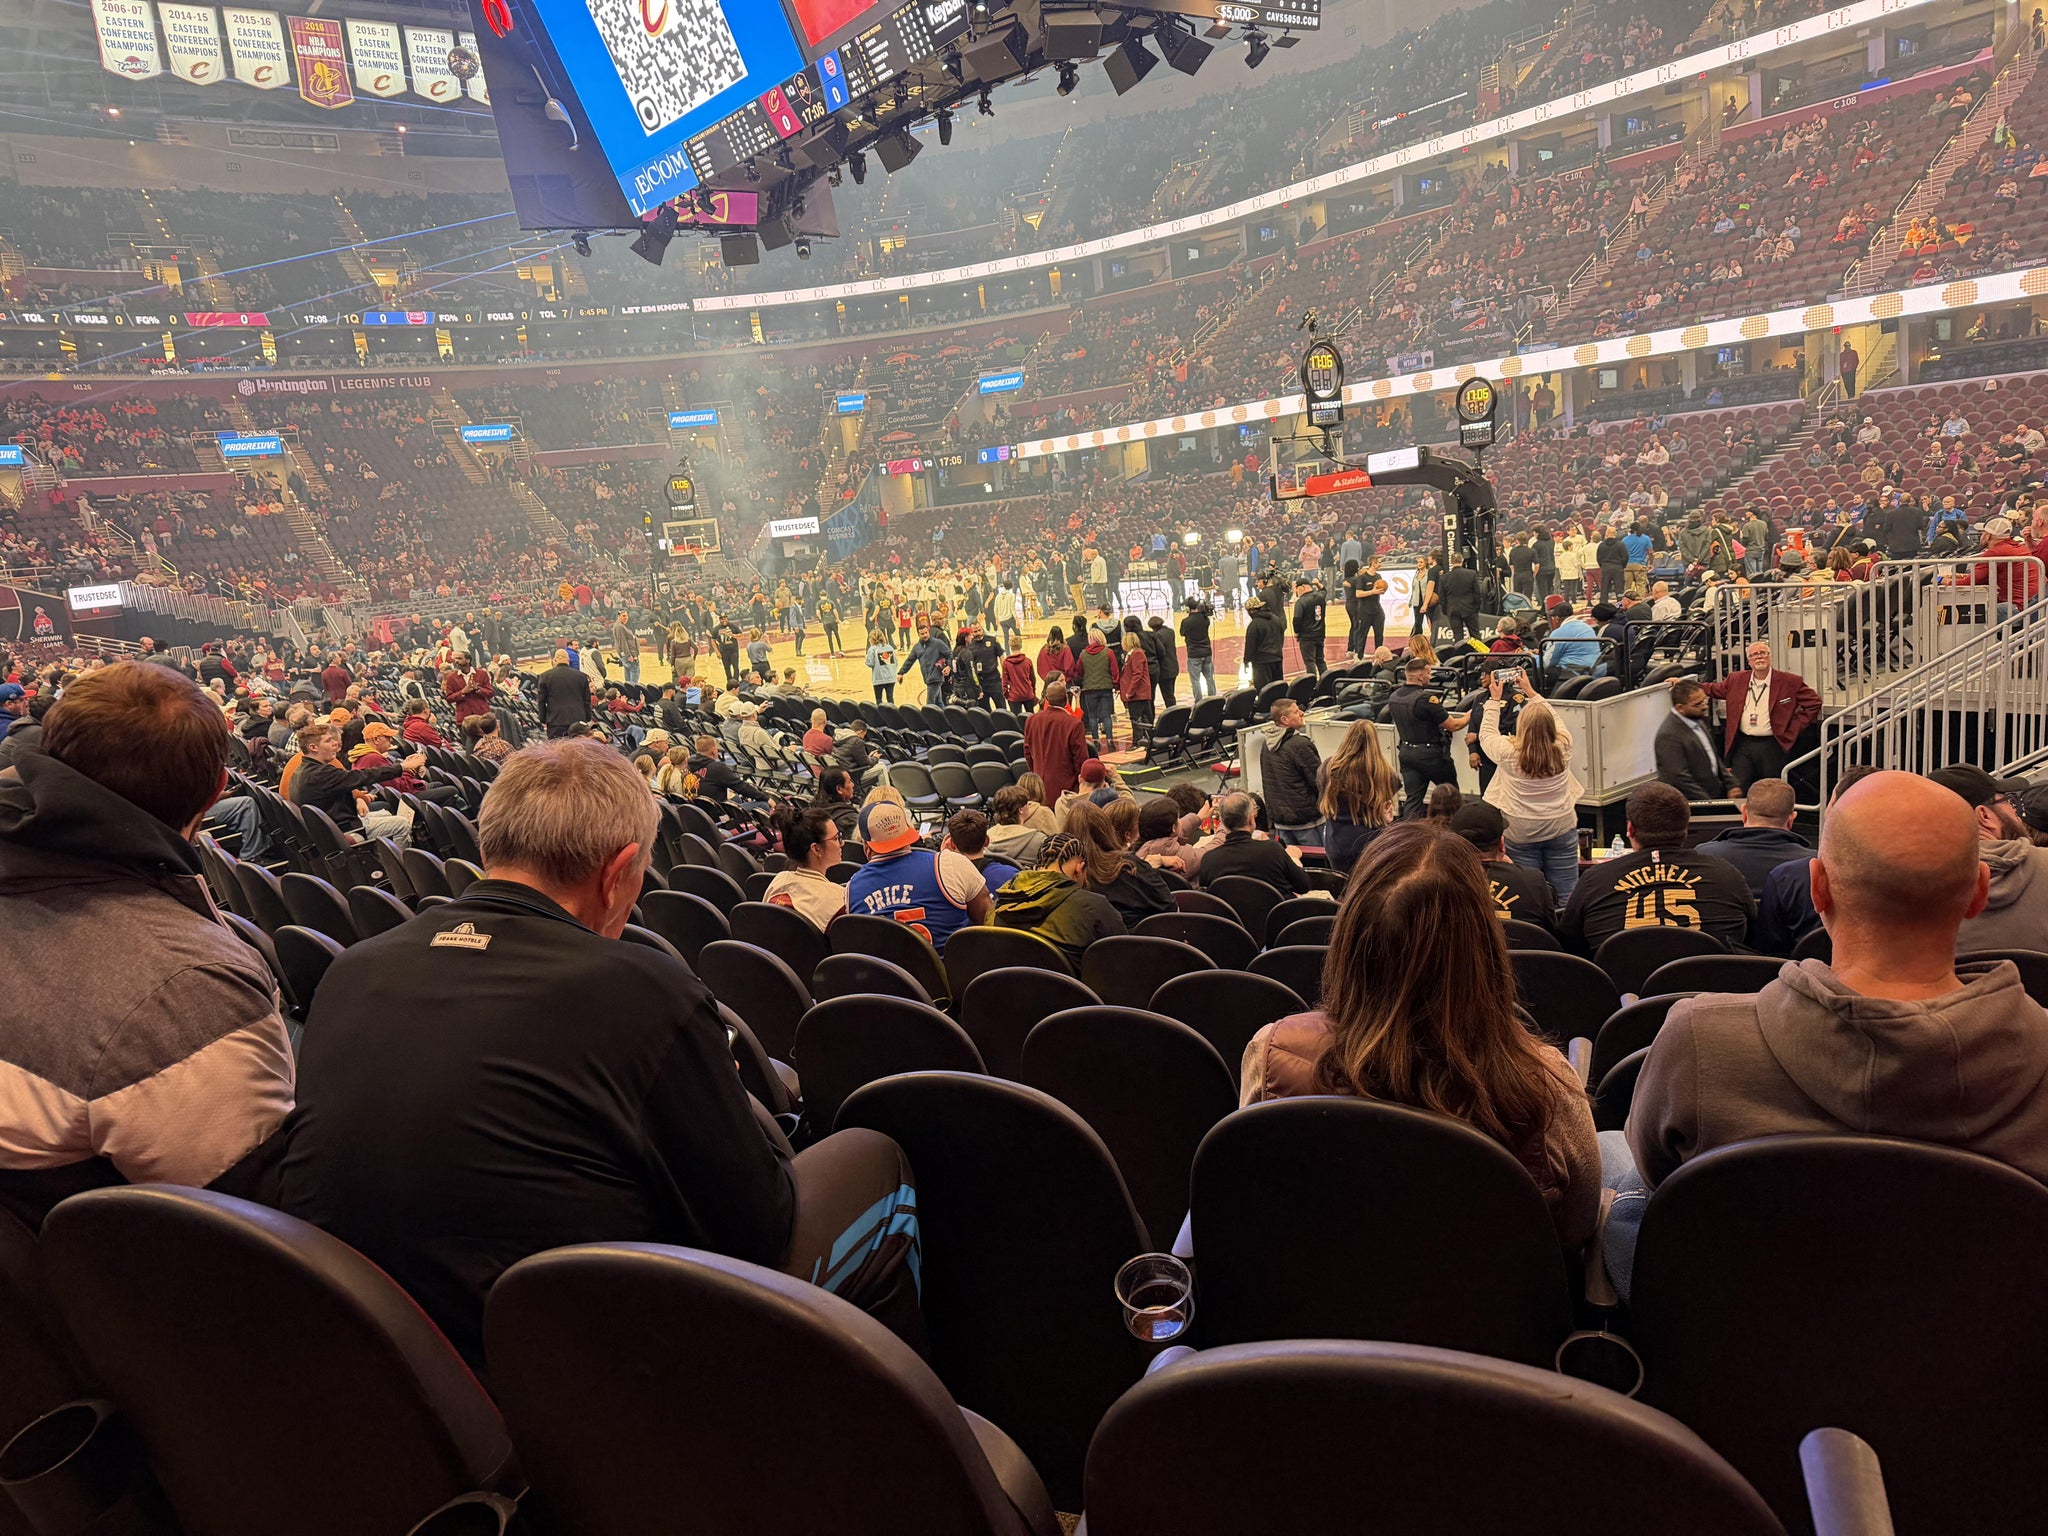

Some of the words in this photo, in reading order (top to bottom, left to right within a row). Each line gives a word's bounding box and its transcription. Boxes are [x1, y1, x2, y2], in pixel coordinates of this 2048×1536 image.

[101, 2, 143, 15] 2006-07
[1220, 5, 1252, 20] $5,000
[168, 9, 209, 22] 2014-15
[232, 14, 272, 26] 2015-16
[105, 16, 145, 28] EASTERN
[304, 21, 325, 32] 2016
[100, 27, 155, 41] CONFERENCE
[172, 23, 209, 35] EASTERN
[237, 27, 272, 39] EASTERN
[355, 25, 390, 37] 2016-17
[168, 33, 219, 46] CONFERENCE
[308, 36, 326, 47] NBA
[359, 38, 391, 49] EASTERN
[412, 32, 447, 44] 2017-18
[105, 39, 155, 52] CHAMPIONS
[172, 44, 218, 57] CHAMPIONS
[232, 38, 282, 51] CONFERENCE
[415, 44, 448, 56] EASTERN
[236, 49, 281, 62] CHAMPIONS
[297, 44, 341, 58] CHAMPIONS
[354, 48, 400, 60] CONFERENCE
[358, 58, 399, 71] CHAMPIONS
[411, 54, 448, 65] CONFEREN
[831, 86, 842, 104] 0
[1840, 96, 1857, 107] 108
[801, 101, 826, 124] 17:06
[781, 114, 792, 132] 0
[1570, 171, 1583, 180] 107
[2012, 256, 2048, 269] Huntington
[1972, 266, 1994, 275] LEVEL
[487, 312, 515, 321] FOULS
[521, 311, 528, 320] 0
[539, 310, 557, 319] TOL
[562, 309, 568, 319] 7
[579, 308, 595, 317] 6:45
[596, 307, 608, 316] PM
[621, 306, 641, 314] LET
[22, 313, 46, 323] TOL
[52, 313, 60, 324] 7
[74, 314, 109, 325] FOULS
[115, 315, 124, 325] 0
[136, 315, 160, 325] FG%
[169, 314, 178, 325] 0
[240, 314, 248, 324] 0
[344, 313, 360, 325] 1Q
[380, 314, 387, 324] 0
[438, 313, 459, 322] FG%
[465, 313, 472, 323] 0
[981, 376, 1021, 389] PROGRESSIVE
[1320, 400, 1342, 409] TISSOT
[671, 413, 714, 423] PROGRESSIVE
[464, 428, 508, 438] PROGRESSIVE
[224, 441, 277, 452] PROGRESSIVE
[981, 451, 988, 461] 0
[912, 460, 920, 470] 0
[774, 521, 816, 532] TRUSTEDSEC
[826, 525, 855, 534] COMCAST
[828, 532, 856, 541] BUSINESS
[73, 590, 118, 603] TRUSTEDSEC
[29, 634, 63, 644] SHERWIN
[1613, 863, 1704, 895] MITCHELL
[863, 884, 914, 915] PRICE
[1624, 888, 1702, 932] 45
